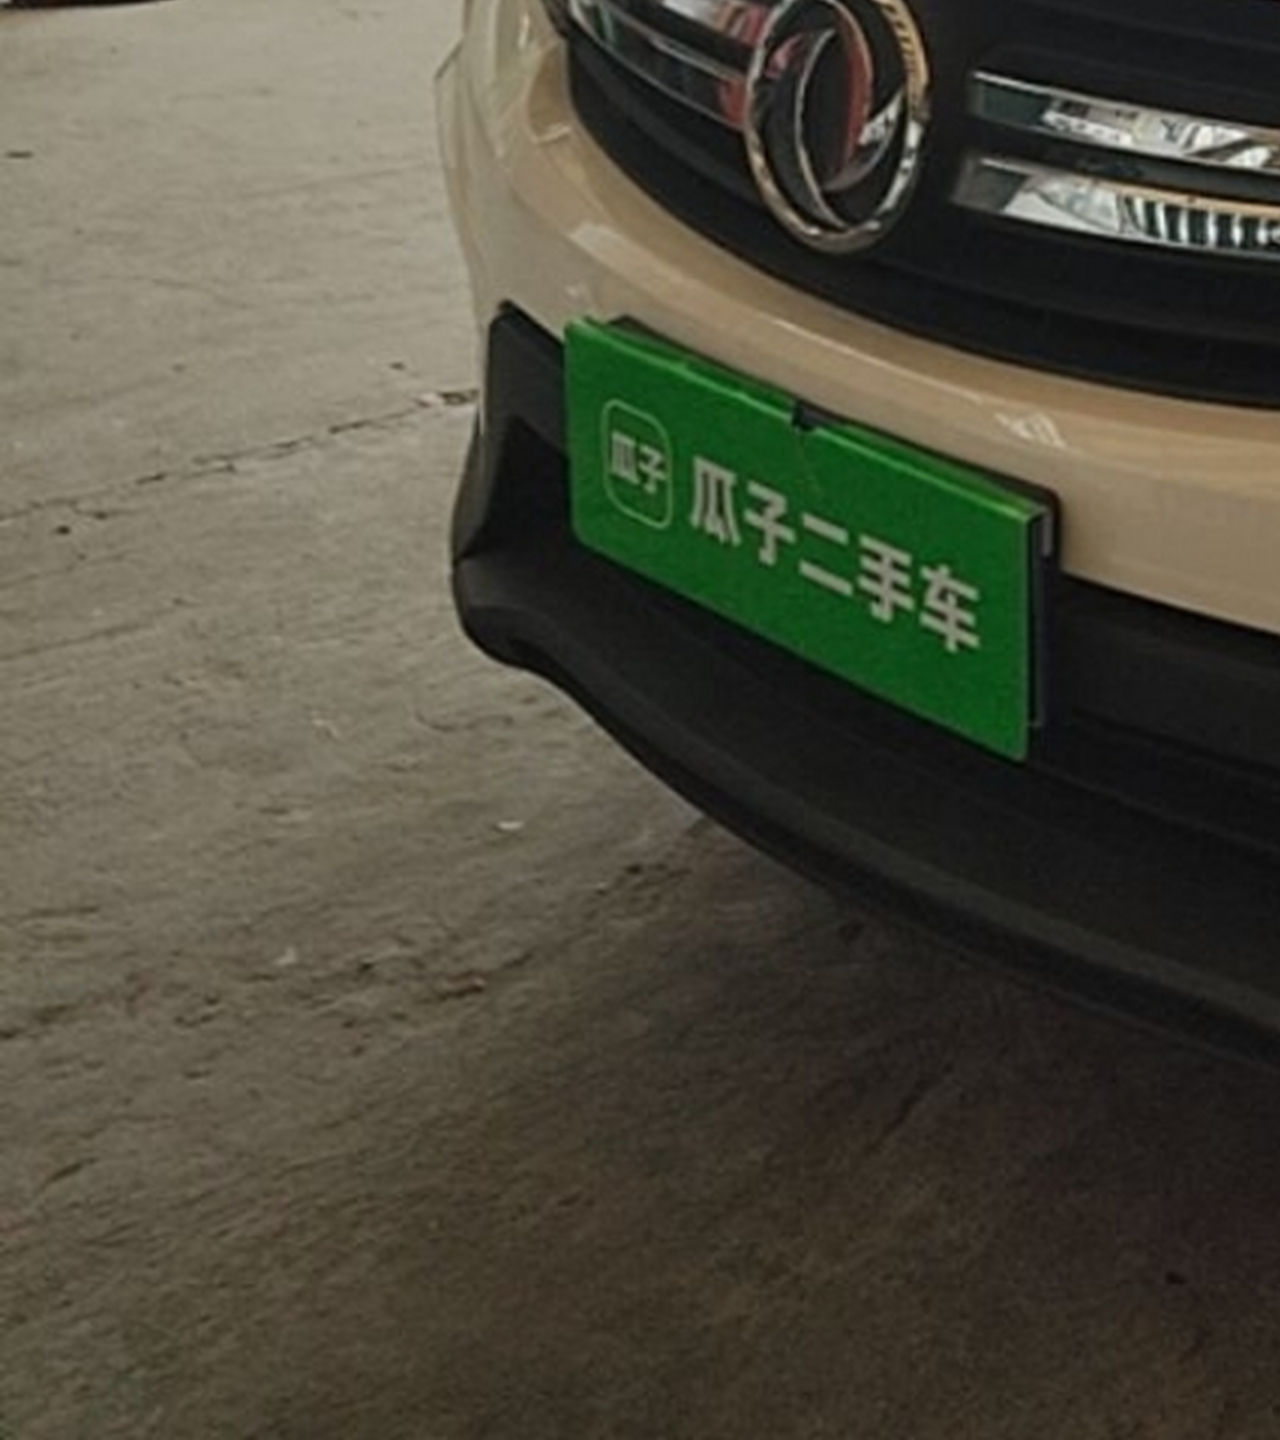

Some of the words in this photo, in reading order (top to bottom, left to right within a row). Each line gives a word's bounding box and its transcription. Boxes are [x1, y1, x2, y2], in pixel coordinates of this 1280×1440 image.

[611, 431, 666, 494] 瓜子
[691, 456, 980, 653] 瓜子二手车
